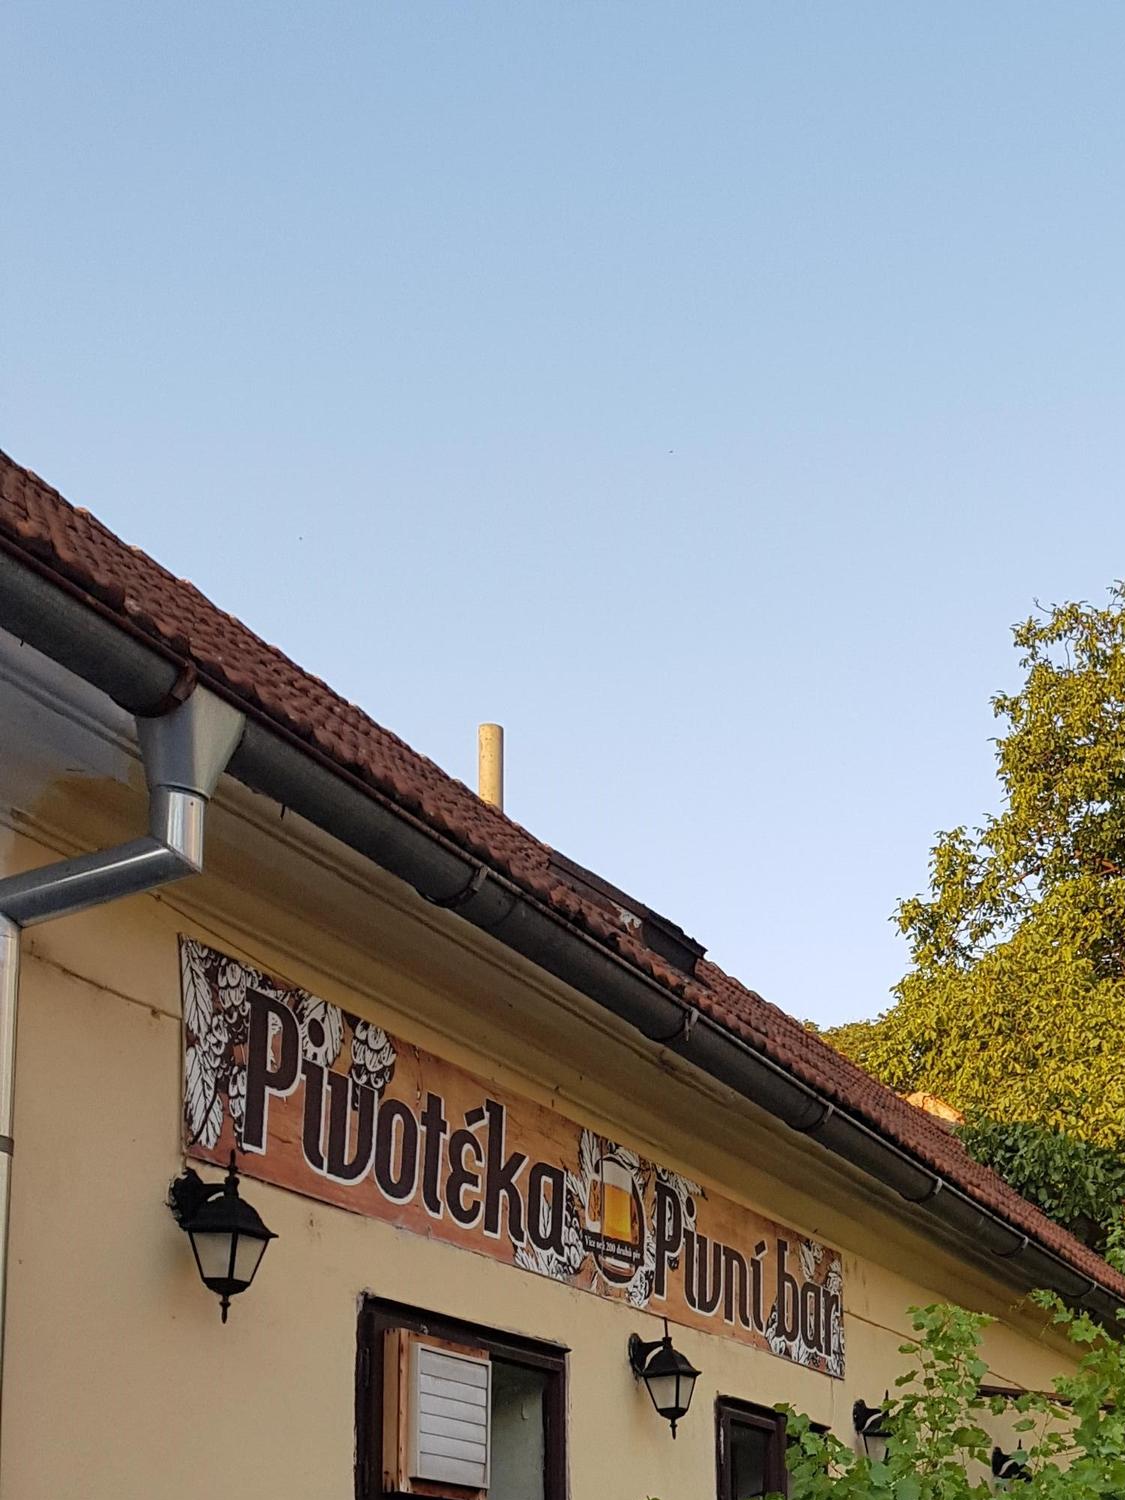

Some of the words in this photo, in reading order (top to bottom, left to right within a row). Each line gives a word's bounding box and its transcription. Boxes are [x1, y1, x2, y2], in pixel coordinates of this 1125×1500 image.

[242, 985, 567, 1257] Pivotéka
[606, 1241, 616, 1253] 200
[654, 1179, 766, 1334] Pivní
[775, 1237, 841, 1358] bar
